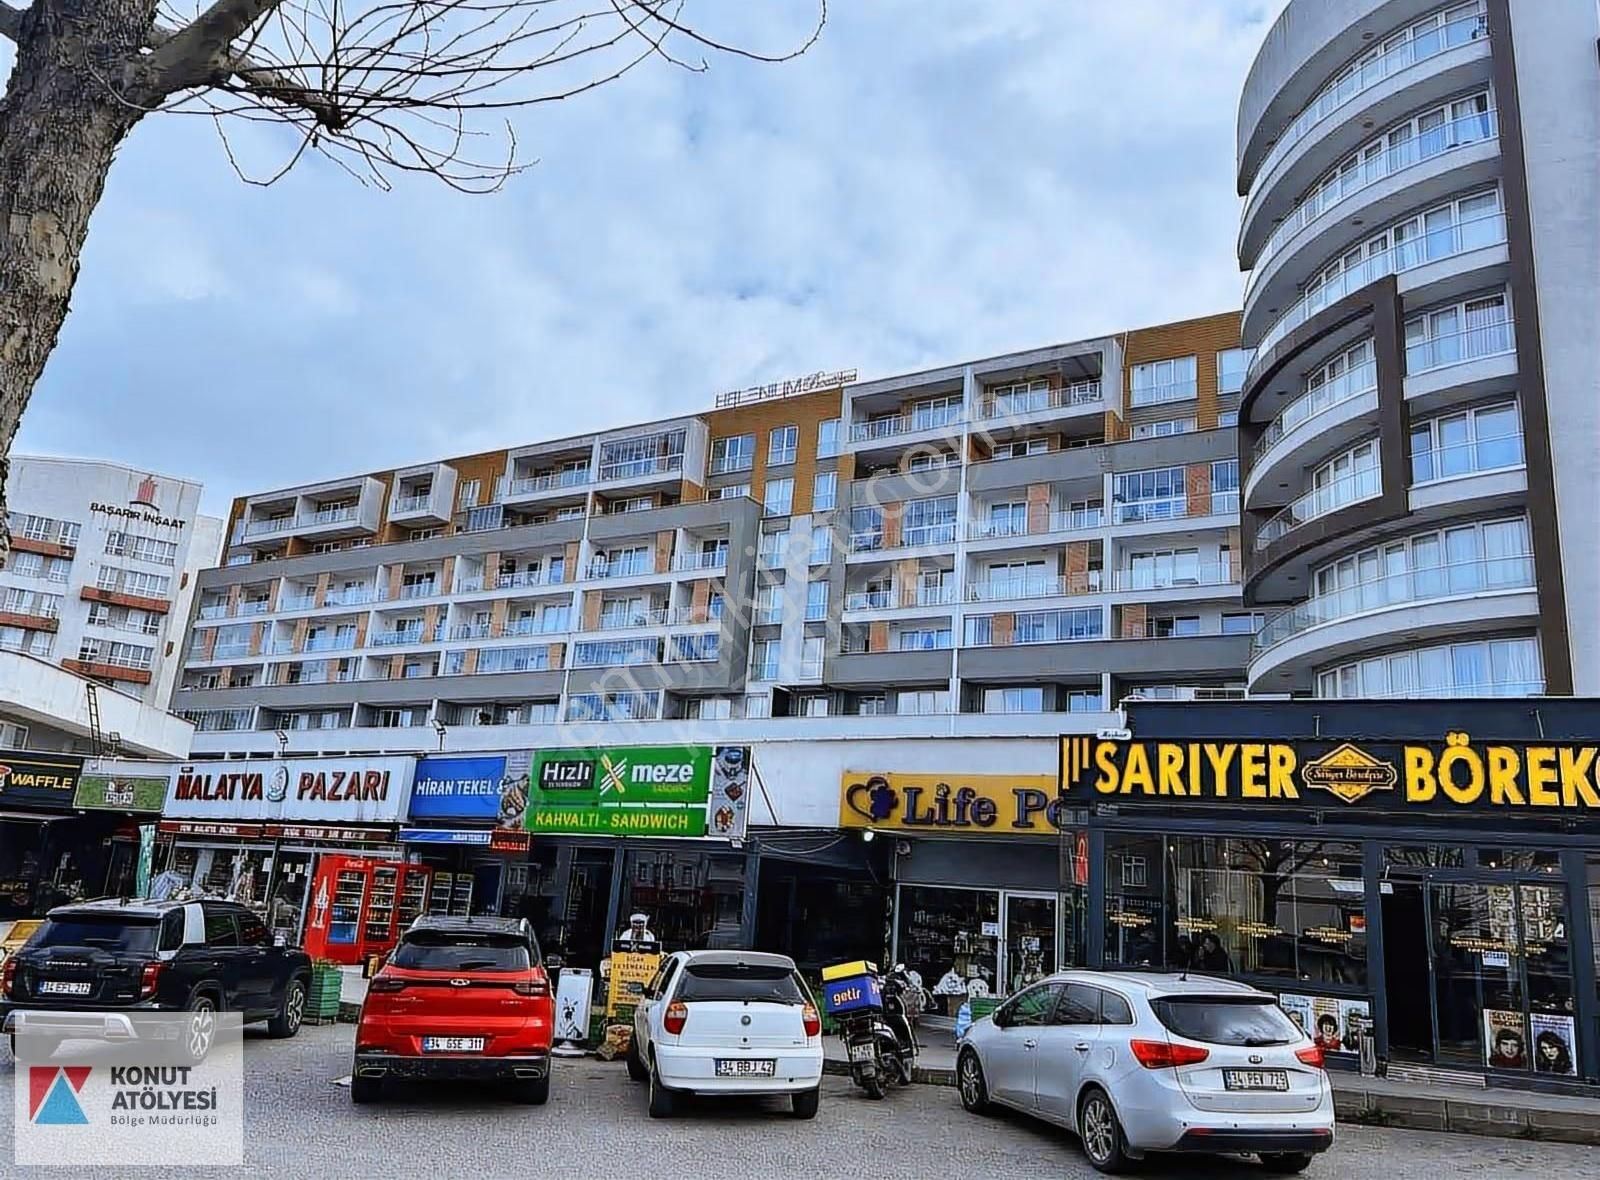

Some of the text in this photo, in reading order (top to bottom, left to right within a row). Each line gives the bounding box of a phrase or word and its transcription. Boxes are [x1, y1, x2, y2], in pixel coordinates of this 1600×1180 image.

[143, 511, 185, 529] İNŞAAT
[632, 763, 694, 783] meze
[1095, 732, 1600, 807] SARIYER BÖREK
[11, 773, 73, 790] WAFFLE
[175, 770, 390, 801] MALATYA PAZARI
[416, 777, 454, 796] MİRAN
[457, 780, 494, 796] TEKEL
[902, 783, 997, 828] Life
[535, 812, 600, 827] KAHVALTI
[610, 814, 689, 830] SANDWICH
[833, 988, 861, 1006] getir
[429, 1038, 440, 1049] 34
[722, 1061, 733, 1071] 34
